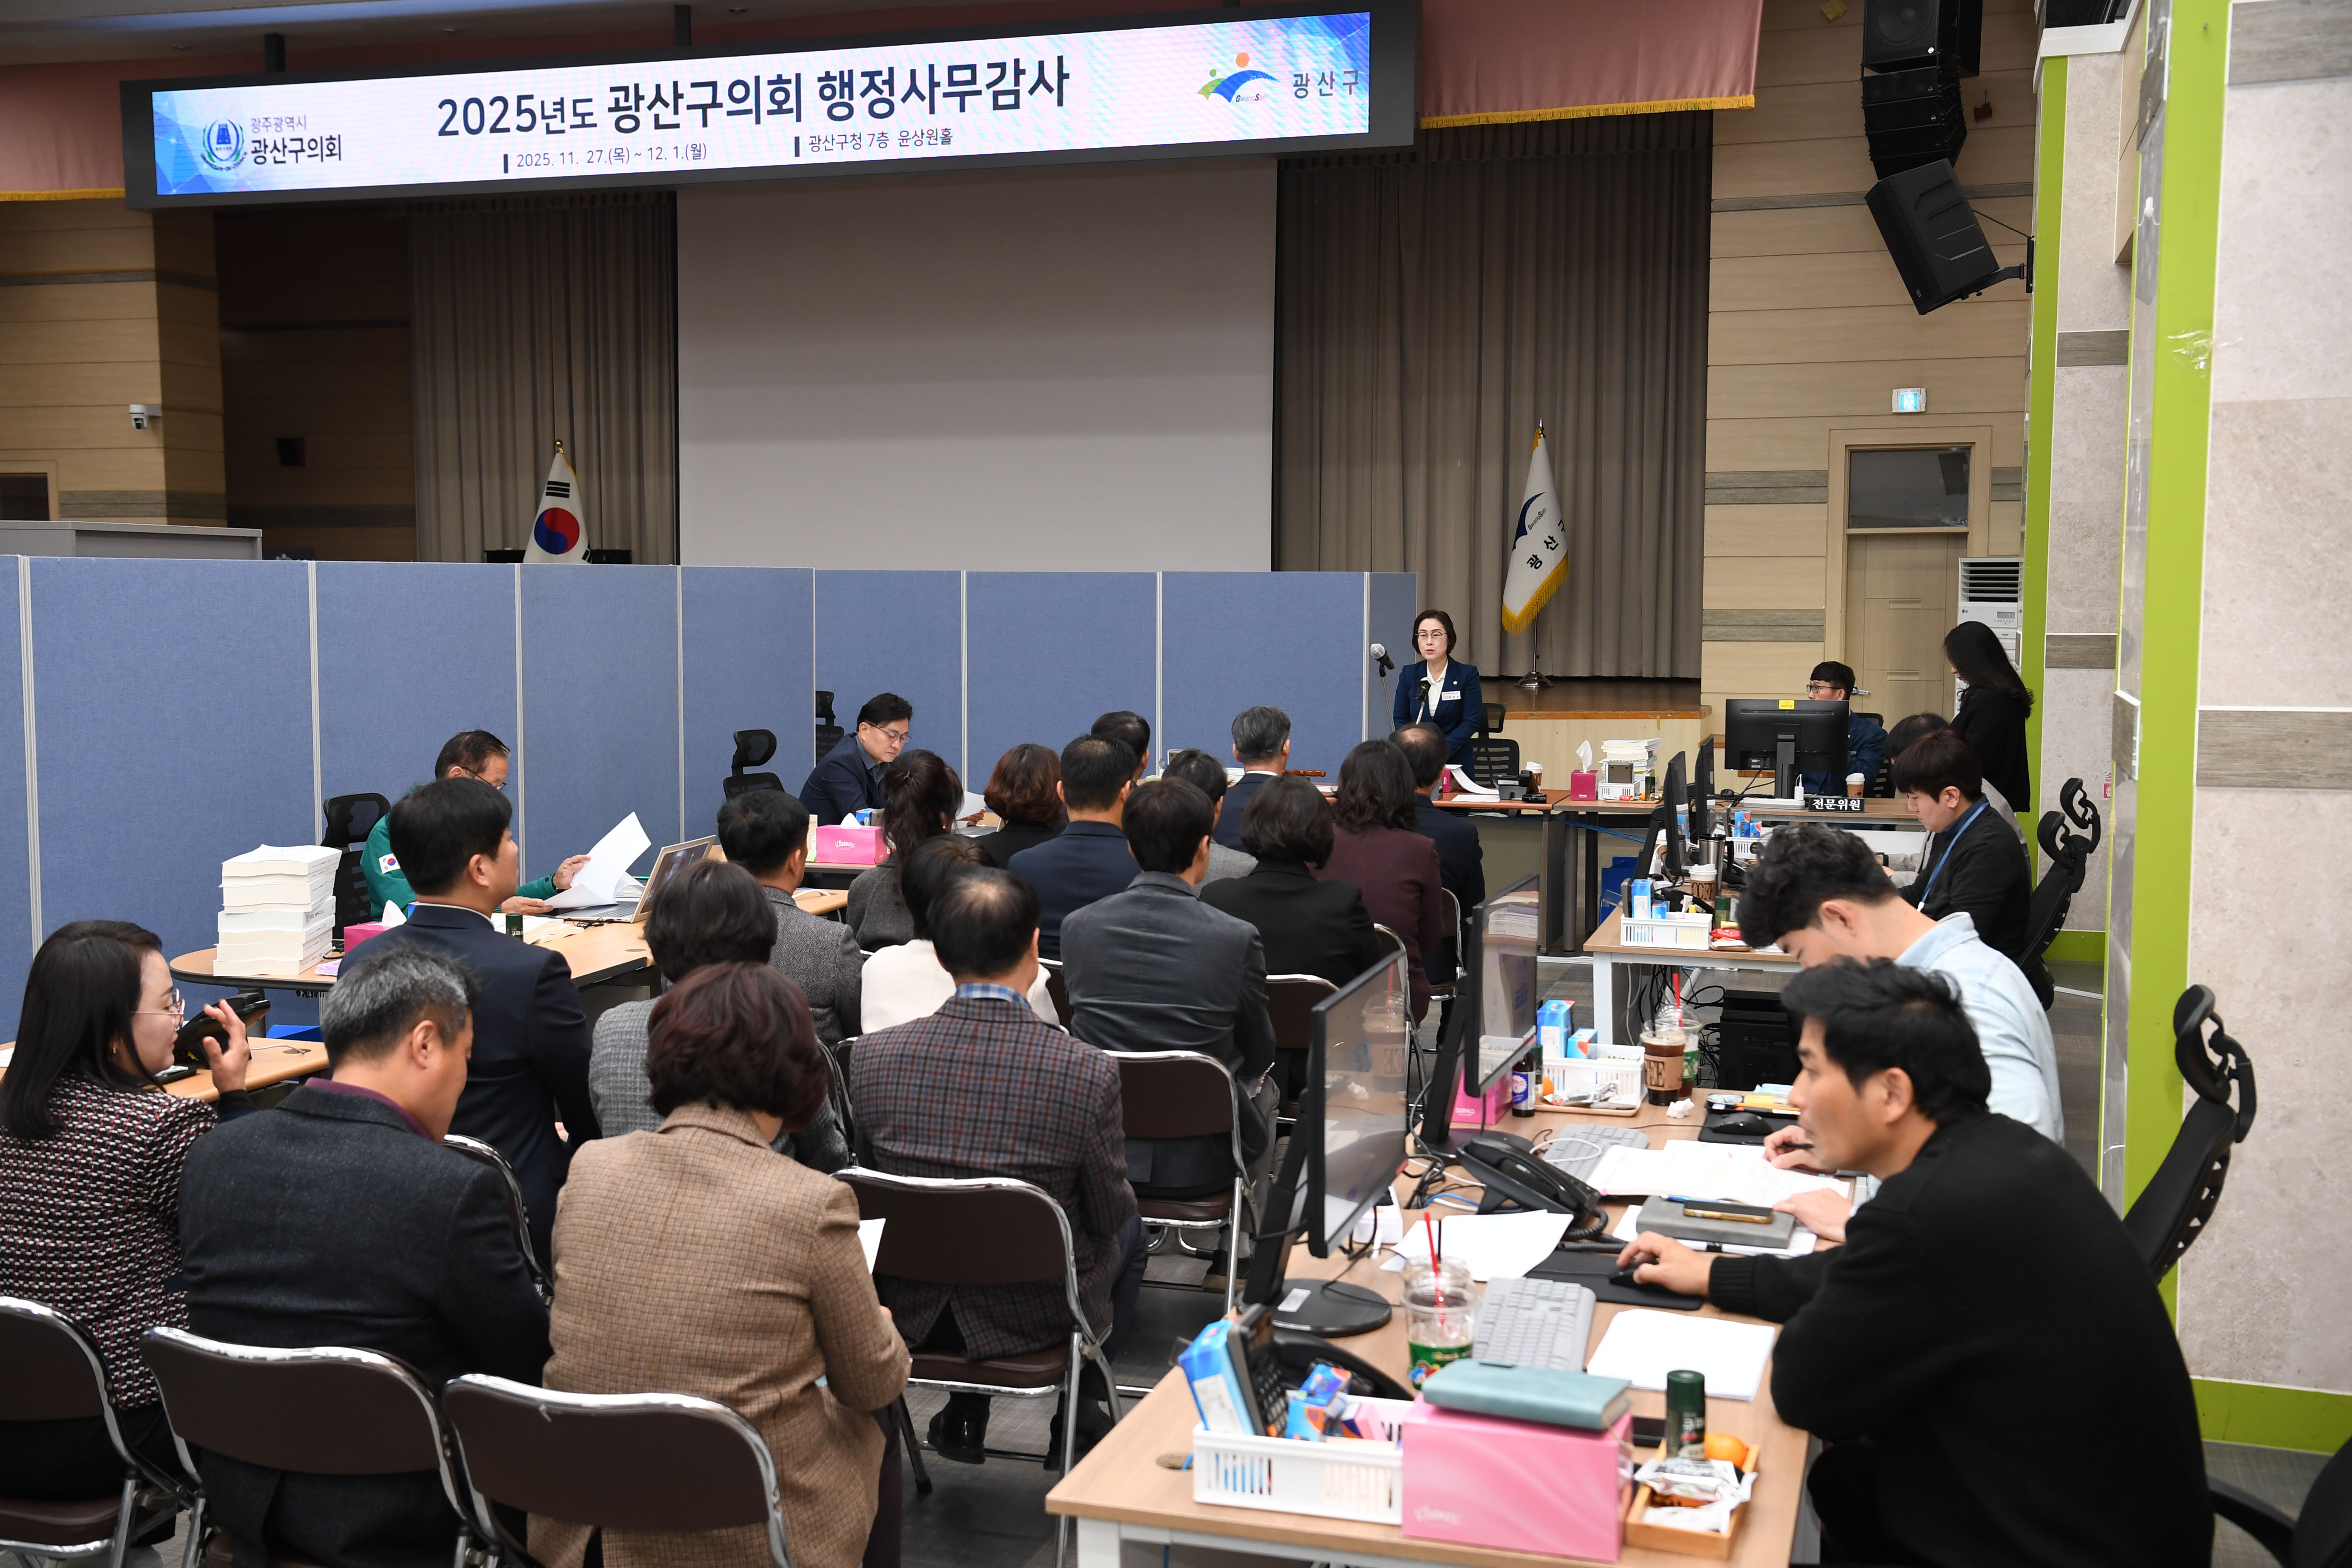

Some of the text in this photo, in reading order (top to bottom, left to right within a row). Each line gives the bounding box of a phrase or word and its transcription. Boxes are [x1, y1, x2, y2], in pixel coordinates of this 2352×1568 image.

[438, 55, 1070, 136] 2025년도 광산구의회 행정사무감사
[251, 115, 307, 133] 광주광역시
[251, 134, 341, 165] 광산구의회
[808, 128, 953, 152] 광산구청 7층 윤상원홀
[517, 152, 554, 167] 2025.
[559, 151, 579, 165] 11.
[648, 147, 667, 161] 12.
[1812, 798, 1861, 811] 전문위원
[835, 839, 856, 849] Kleenex
